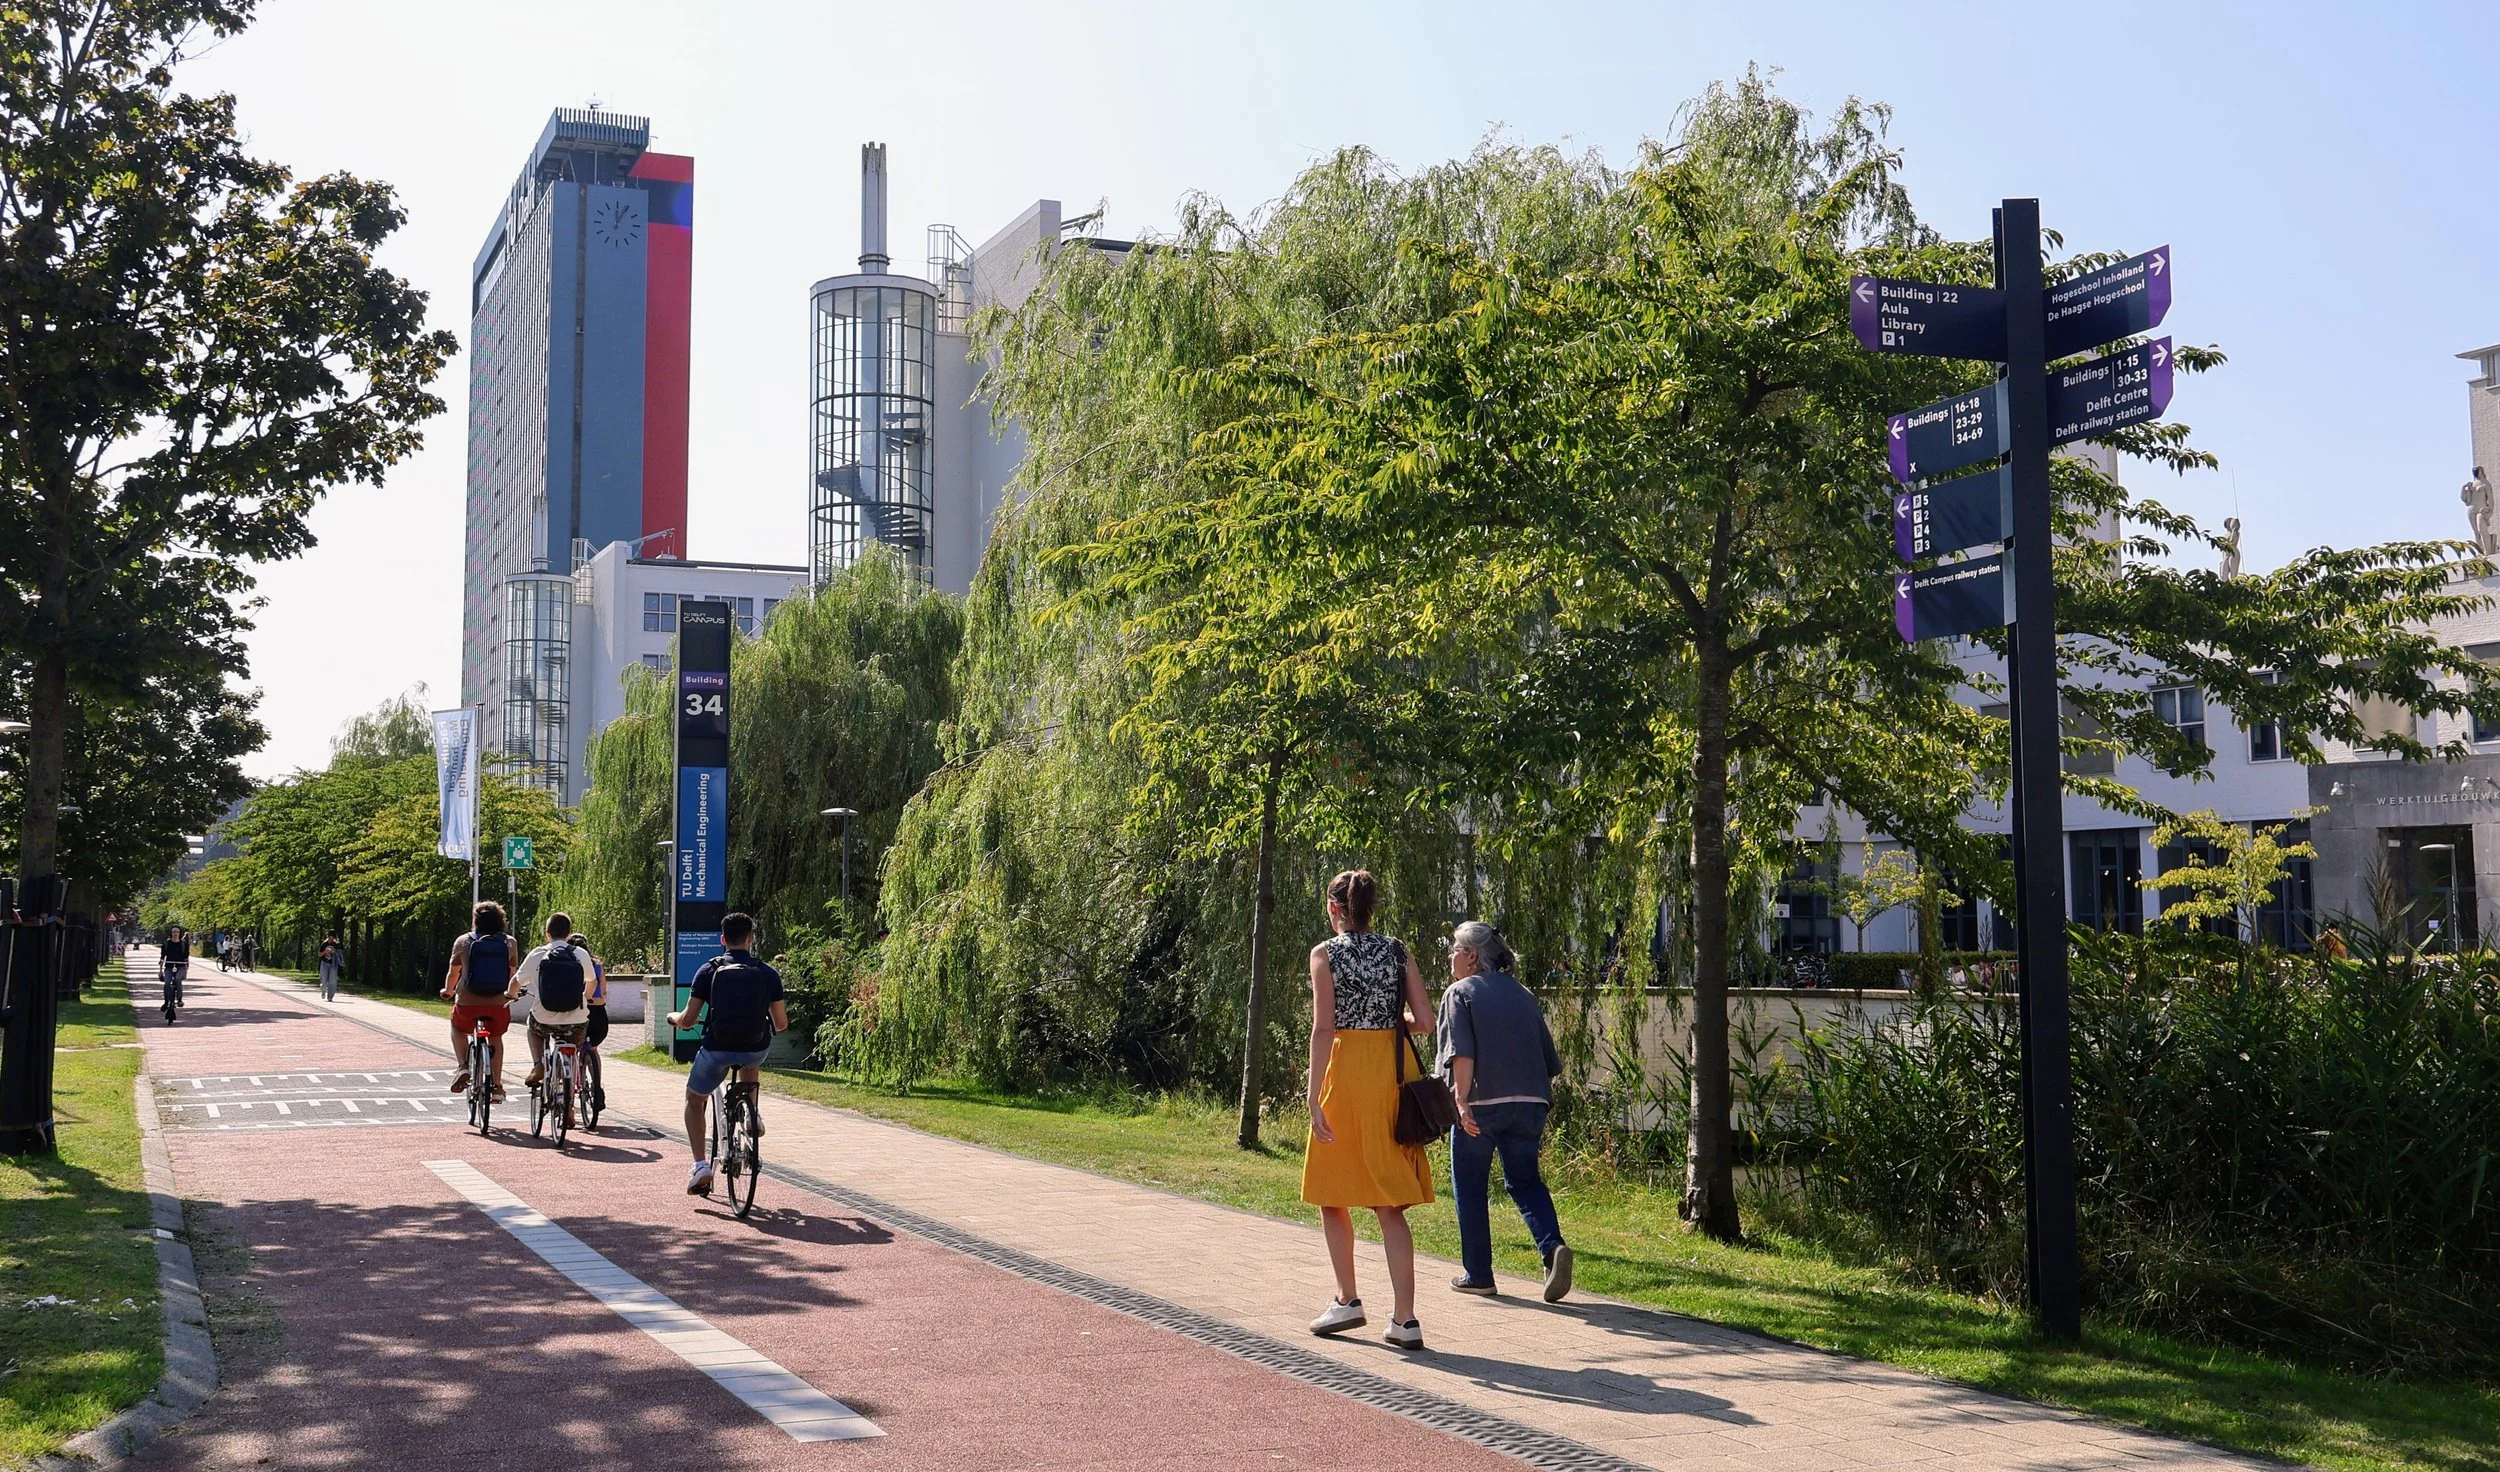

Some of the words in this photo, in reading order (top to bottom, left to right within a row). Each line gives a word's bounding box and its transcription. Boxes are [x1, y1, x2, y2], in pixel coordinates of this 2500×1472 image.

[2052, 278, 2100, 304] Hogeschool
[2102, 262, 2144, 286] Inholland
[1881, 286, 1933, 304] Building
[1943, 292, 1958, 303] 22
[2048, 311, 2059, 322] De
[2061, 300, 2092, 317] Haagse
[2094, 279, 2145, 306] Hogeschool
[1881, 302, 1909, 315] Aula
[1881, 318, 1926, 334] Library
[1898, 335, 1905, 346] 1
[2063, 366, 2109, 387] Buildings
[2117, 354, 2139, 370] 1-15
[2117, 368, 2148, 388] 30-33
[1955, 397, 1980, 414] 16-18
[2086, 396, 2112, 413] Delft
[2114, 387, 2148, 405] Centre
[1908, 409, 1948, 428] Buildings
[1956, 412, 1982, 429] 23-29
[2055, 422, 2078, 438] Delft
[2080, 414, 2114, 432] railway
[2116, 404, 2149, 421] station
[1956, 427, 1983, 444] 34-69
[1923, 495, 1929, 506] 5
[1924, 510, 1929, 520] 2
[1924, 524, 1930, 535] 4
[1924, 540, 1930, 550] 3
[1914, 578, 1929, 588] Delft
[1930, 574, 1954, 585] Campus
[1955, 569, 1977, 580] railway
[1978, 564, 2000, 575] station
[683, 616, 726, 624] CAMPUS
[686, 676, 724, 686] Building
[685, 693, 724, 716] 34
[697, 773, 710, 836] Engineering
[682, 854, 693, 880] Delft
[696, 839, 706, 897] Mechanical
[682, 883, 692, 897] TU
